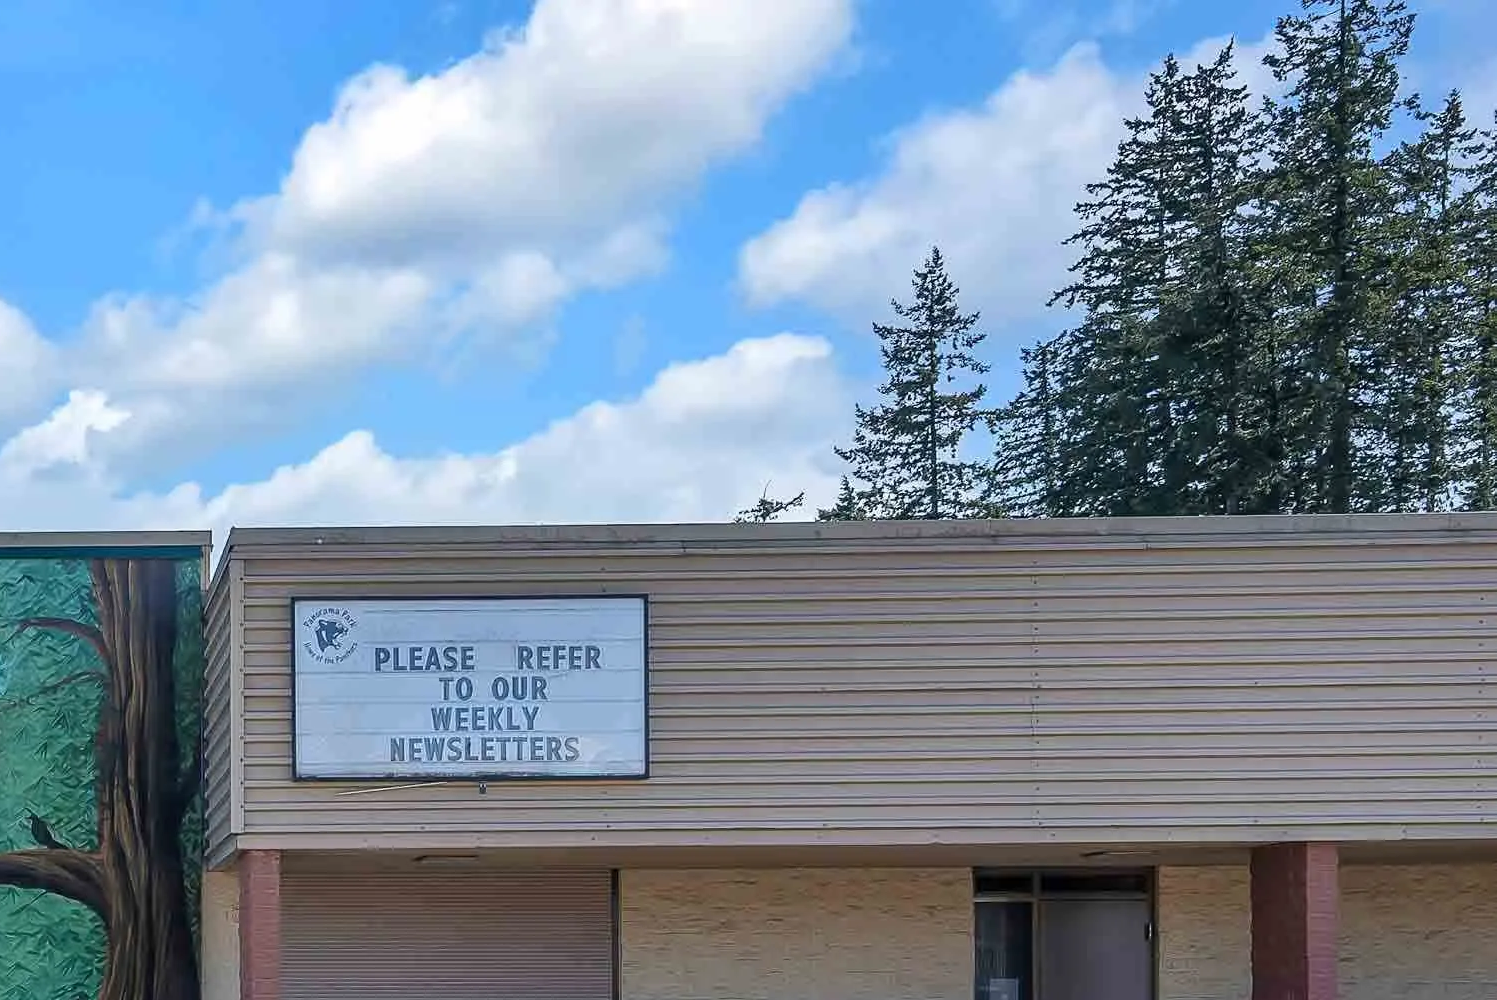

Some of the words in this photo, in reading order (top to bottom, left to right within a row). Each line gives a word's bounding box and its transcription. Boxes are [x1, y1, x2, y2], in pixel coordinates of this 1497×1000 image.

[374, 646, 476, 672] PLEASE
[517, 645, 602, 671] REFER
[438, 676, 474, 701] TO
[491, 676, 549, 701] OUR
[431, 706, 539, 731] WEEKLY
[390, 736, 580, 762] NEWSLETTERS
